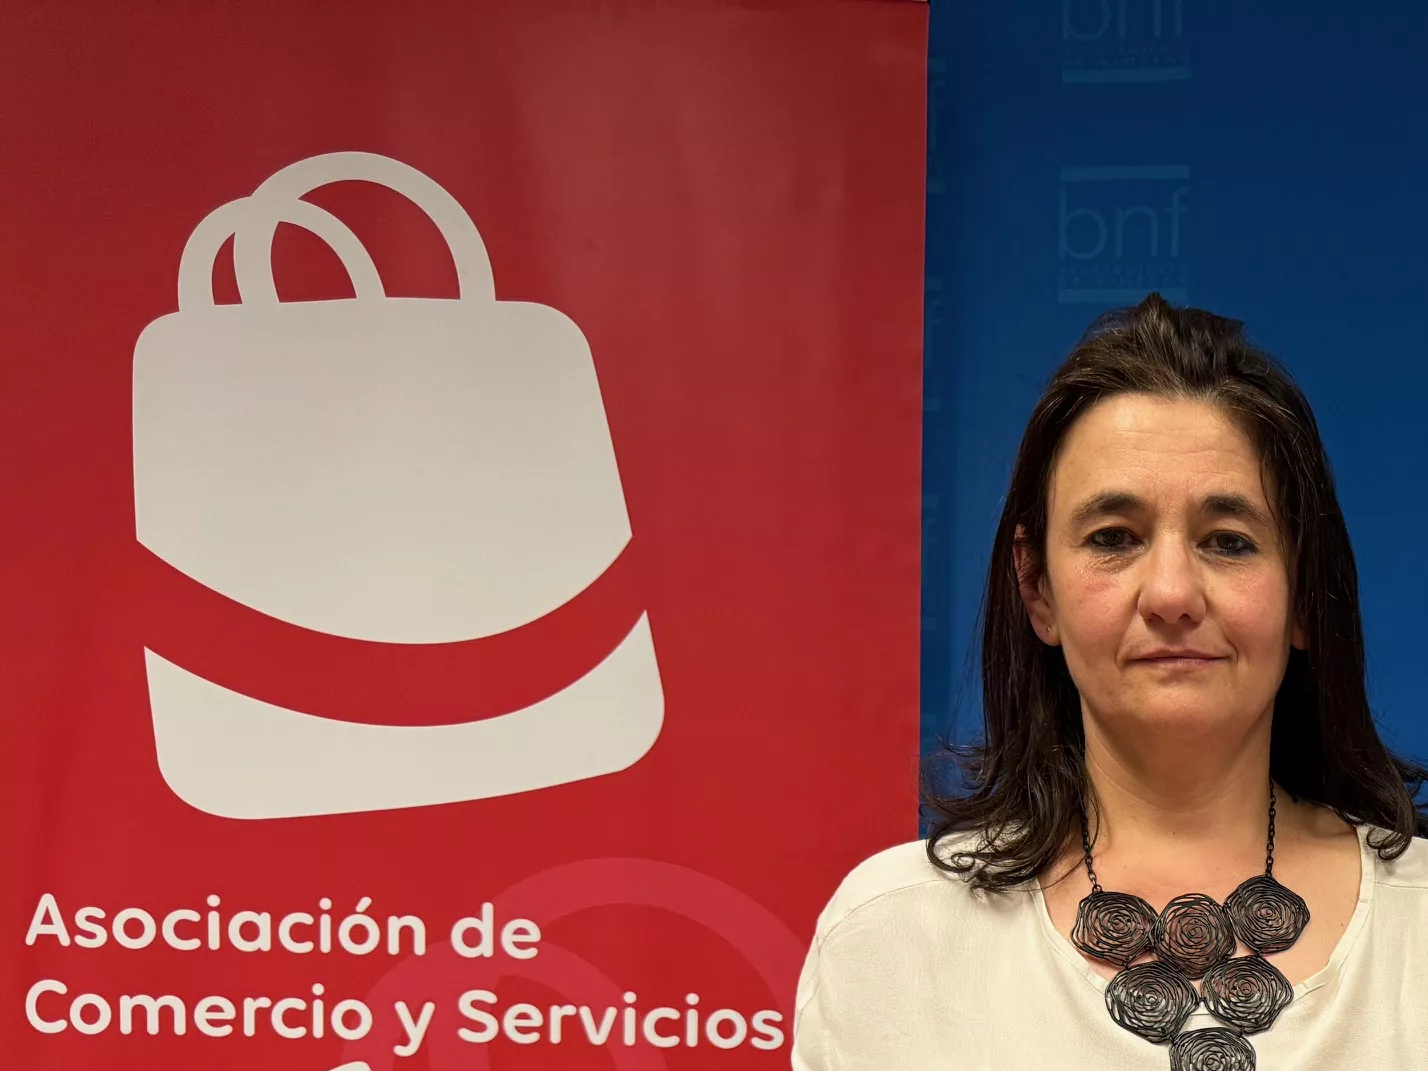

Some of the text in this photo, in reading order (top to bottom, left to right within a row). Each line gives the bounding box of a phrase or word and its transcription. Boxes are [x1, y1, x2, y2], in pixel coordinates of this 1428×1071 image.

[1058, 186, 1190, 259] bnf
[25, 892, 541, 960] Asociación de
[25, 978, 784, 1057] Comercio y Servicios
